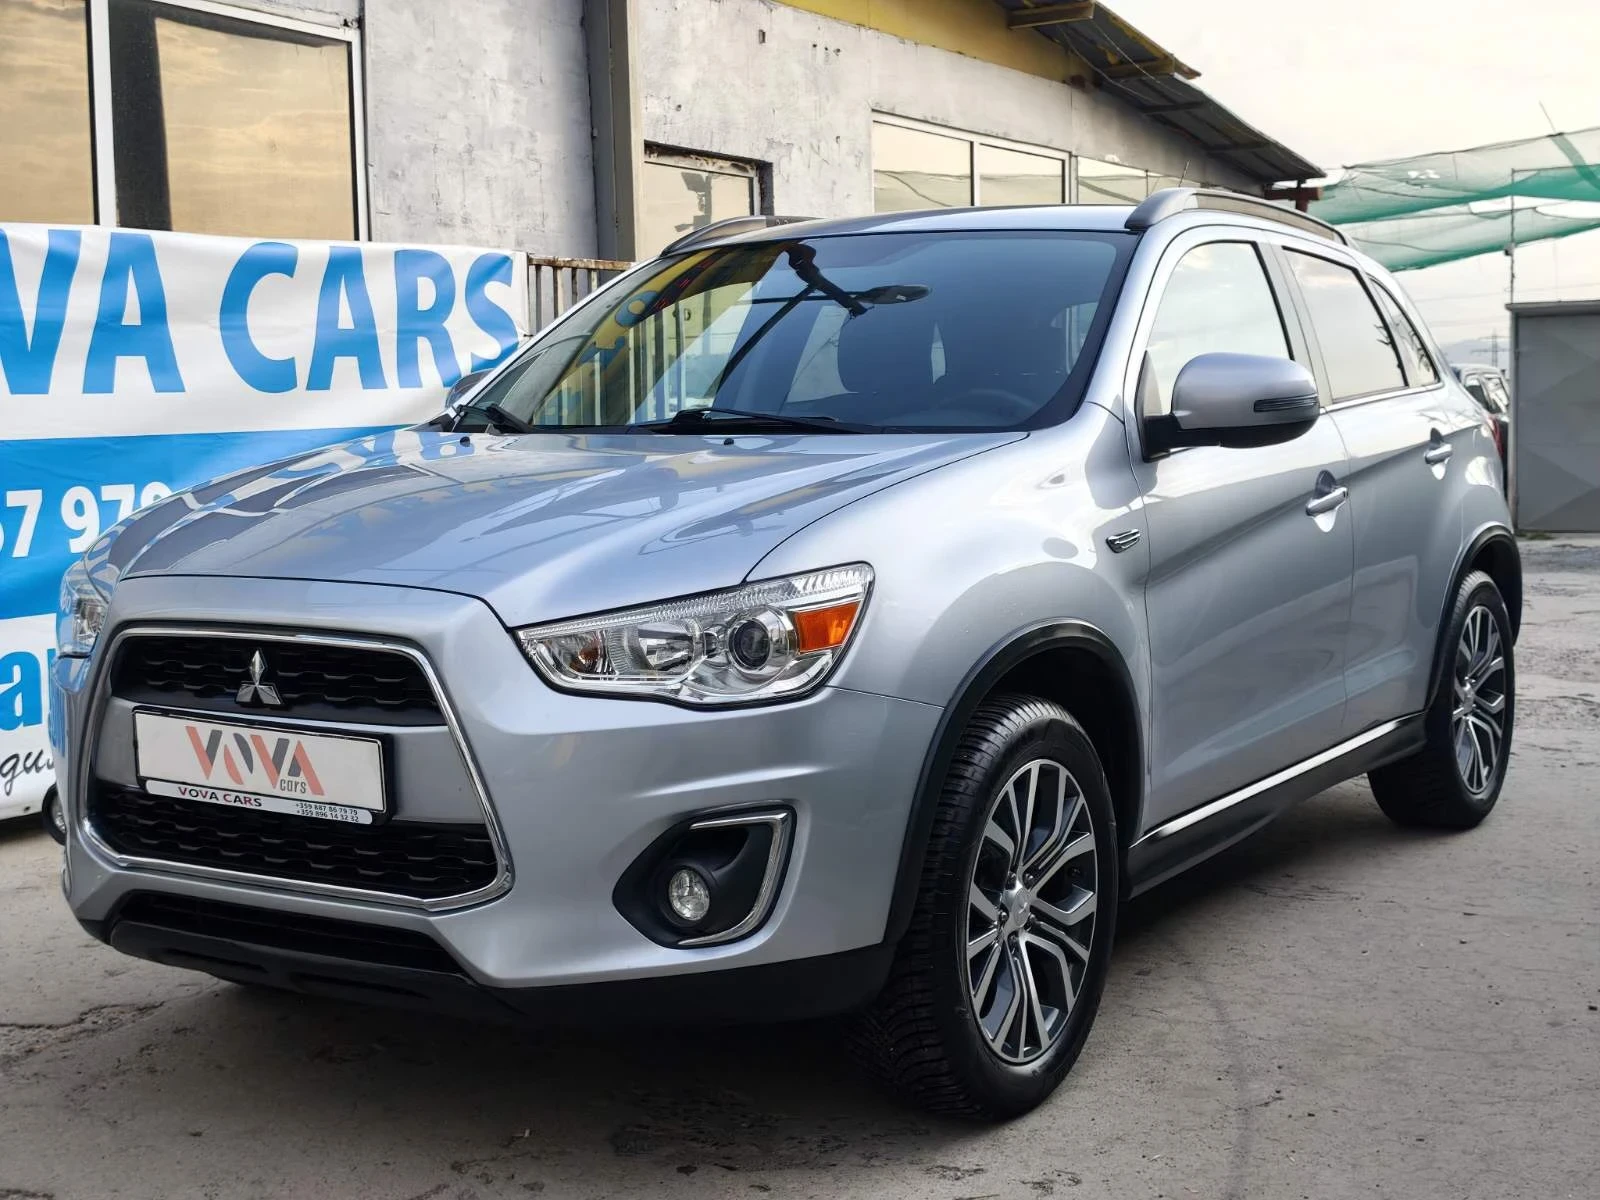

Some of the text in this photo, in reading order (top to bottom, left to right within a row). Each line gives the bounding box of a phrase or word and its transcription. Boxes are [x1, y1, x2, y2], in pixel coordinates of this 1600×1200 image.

[219, 242, 520, 393] CARS
[185, 725, 325, 796] VOVA
[178, 786, 262, 807] VOVA CARS
[279, 778, 307, 794] cars
